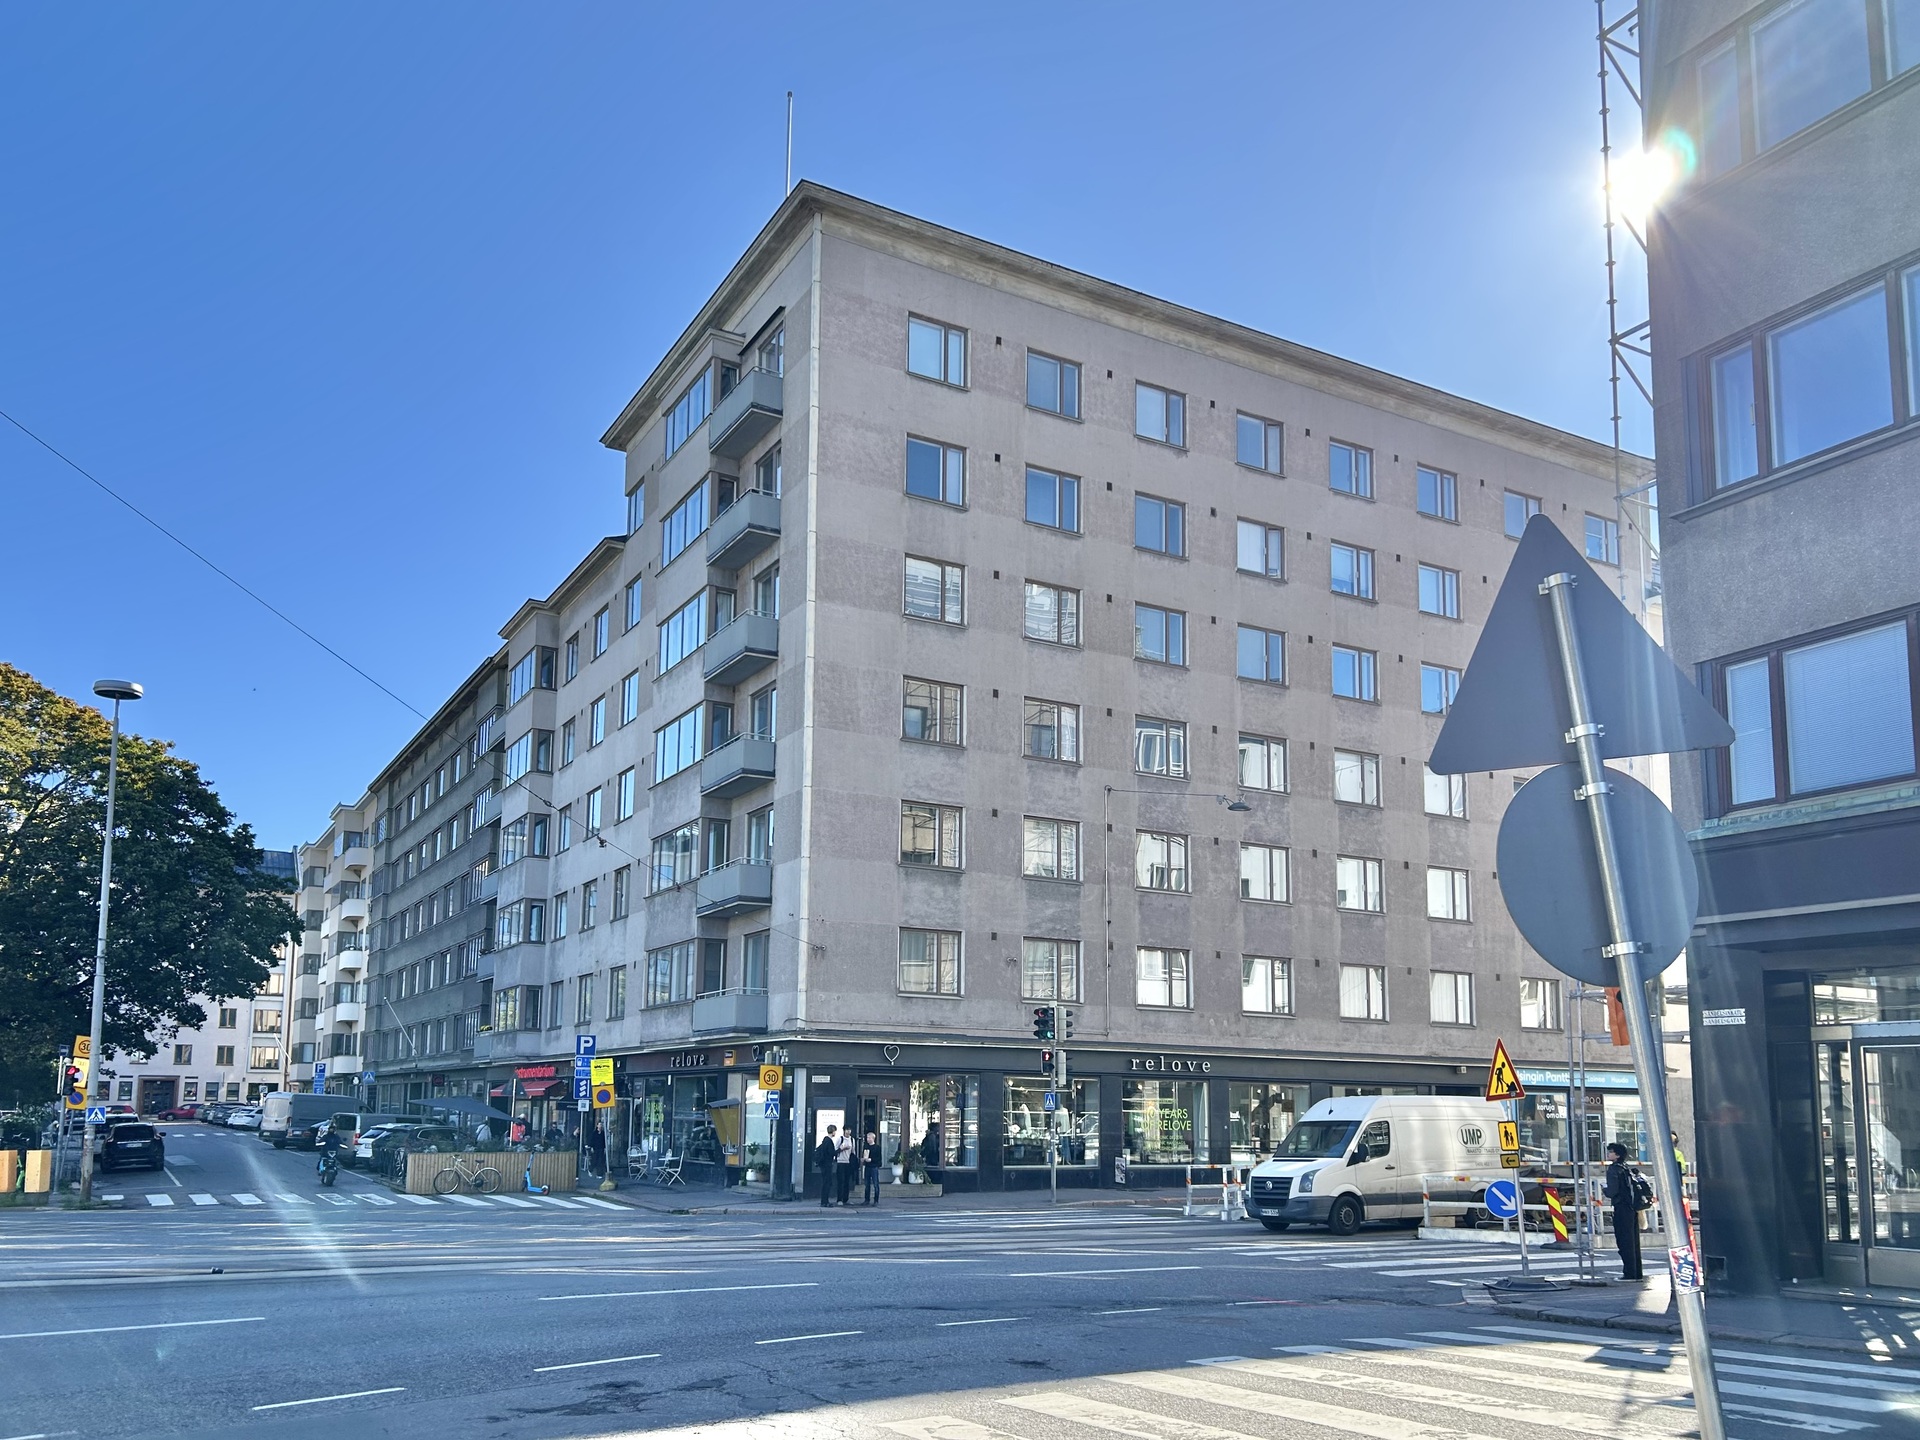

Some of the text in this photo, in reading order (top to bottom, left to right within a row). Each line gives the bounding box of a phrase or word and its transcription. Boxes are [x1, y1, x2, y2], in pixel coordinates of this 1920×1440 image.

[580, 1036, 593, 1054] P
[670, 1052, 705, 1068] relove
[1131, 1055, 1211, 1073] relove
[766, 1073, 776, 1083] 30
[1517, 1070, 1544, 1084] lsingin
[1159, 1108, 1188, 1119] YEARS
[1536, 1103, 1556, 1112] koruja
[1157, 1120, 1192, 1131] RELOVE
[1460, 1128, 1482, 1145] UMP
